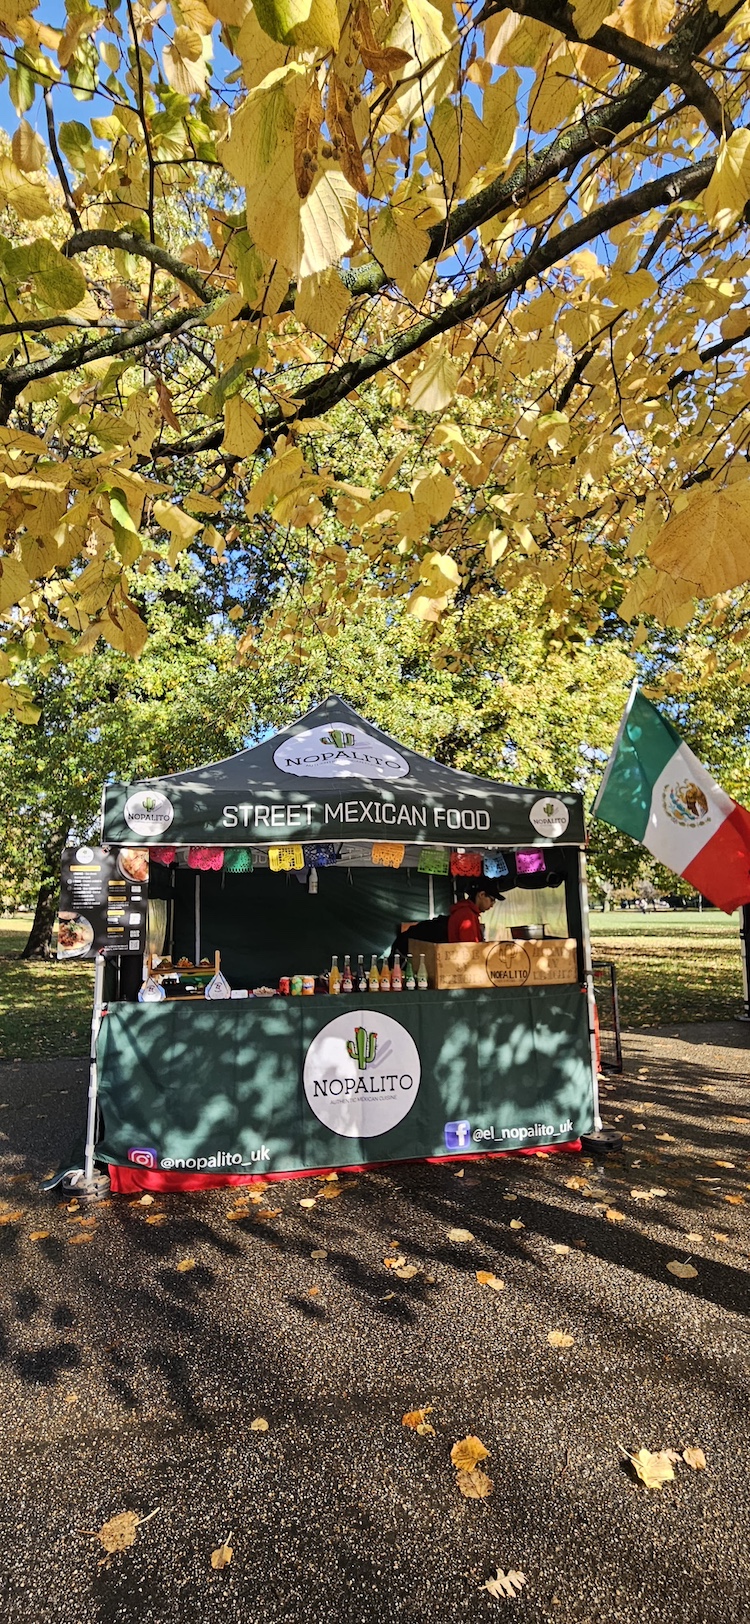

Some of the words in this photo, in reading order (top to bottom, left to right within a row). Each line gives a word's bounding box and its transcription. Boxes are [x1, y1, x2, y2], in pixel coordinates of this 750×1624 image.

[284, 750, 401, 769] NOPALITO
[127, 813, 170, 822] NOPALITO
[222, 803, 316, 828] STREET
[324, 800, 427, 827] MEXICAN
[433, 807, 491, 831] FOOD
[533, 817, 567, 825] NOPALITO
[313, 1074, 413, 1097] NOPALITO
[472, 1119, 574, 1142] @el_nopalito_uk
[160, 1145, 270, 1170] @nopalito_uk
